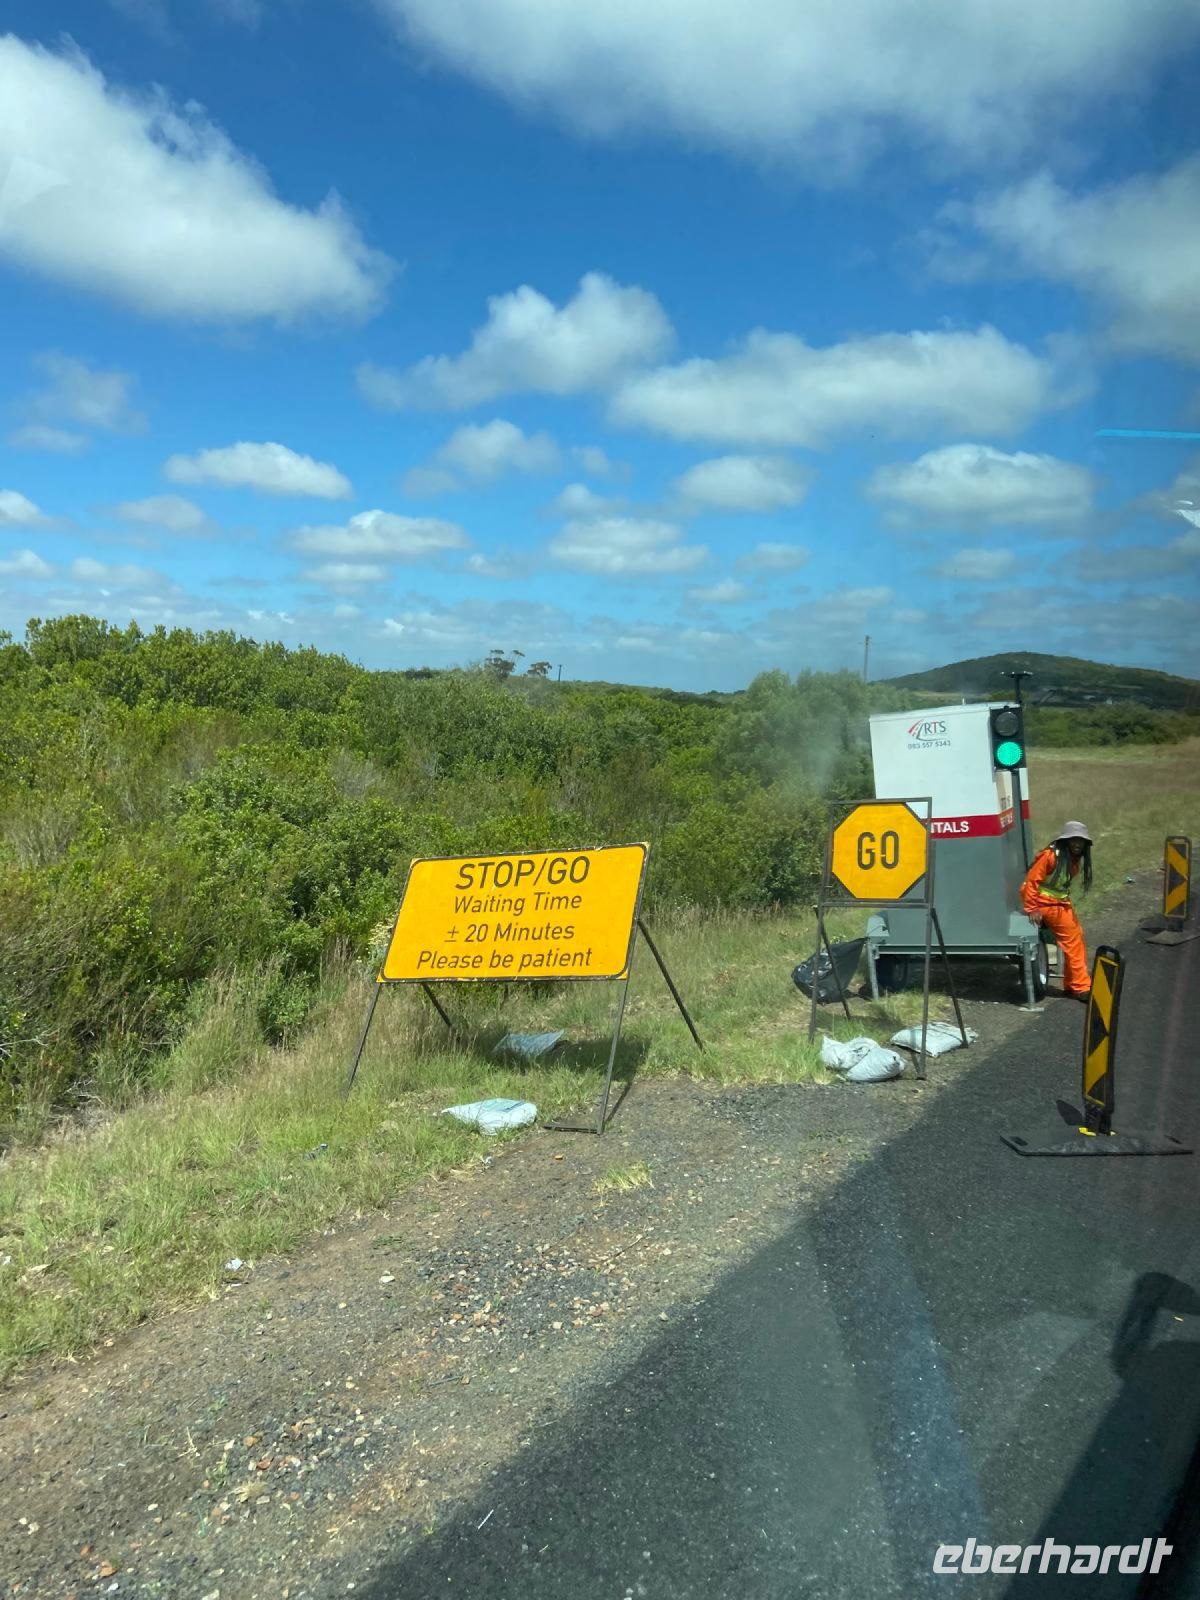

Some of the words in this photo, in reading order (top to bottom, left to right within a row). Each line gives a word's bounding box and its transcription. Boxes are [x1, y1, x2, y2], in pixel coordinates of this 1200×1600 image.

[924, 720, 946, 734] RTS
[857, 830, 900, 870] GO
[455, 855, 591, 890] STOP/GO
[454, 894, 526, 916] Waiting
[533, 892, 583, 911] Time
[463, 923, 489, 943] 20
[493, 922, 576, 942] Minutes
[416, 950, 484, 970] Please
[488, 950, 513, 969] be
[518, 948, 593, 973] patient
